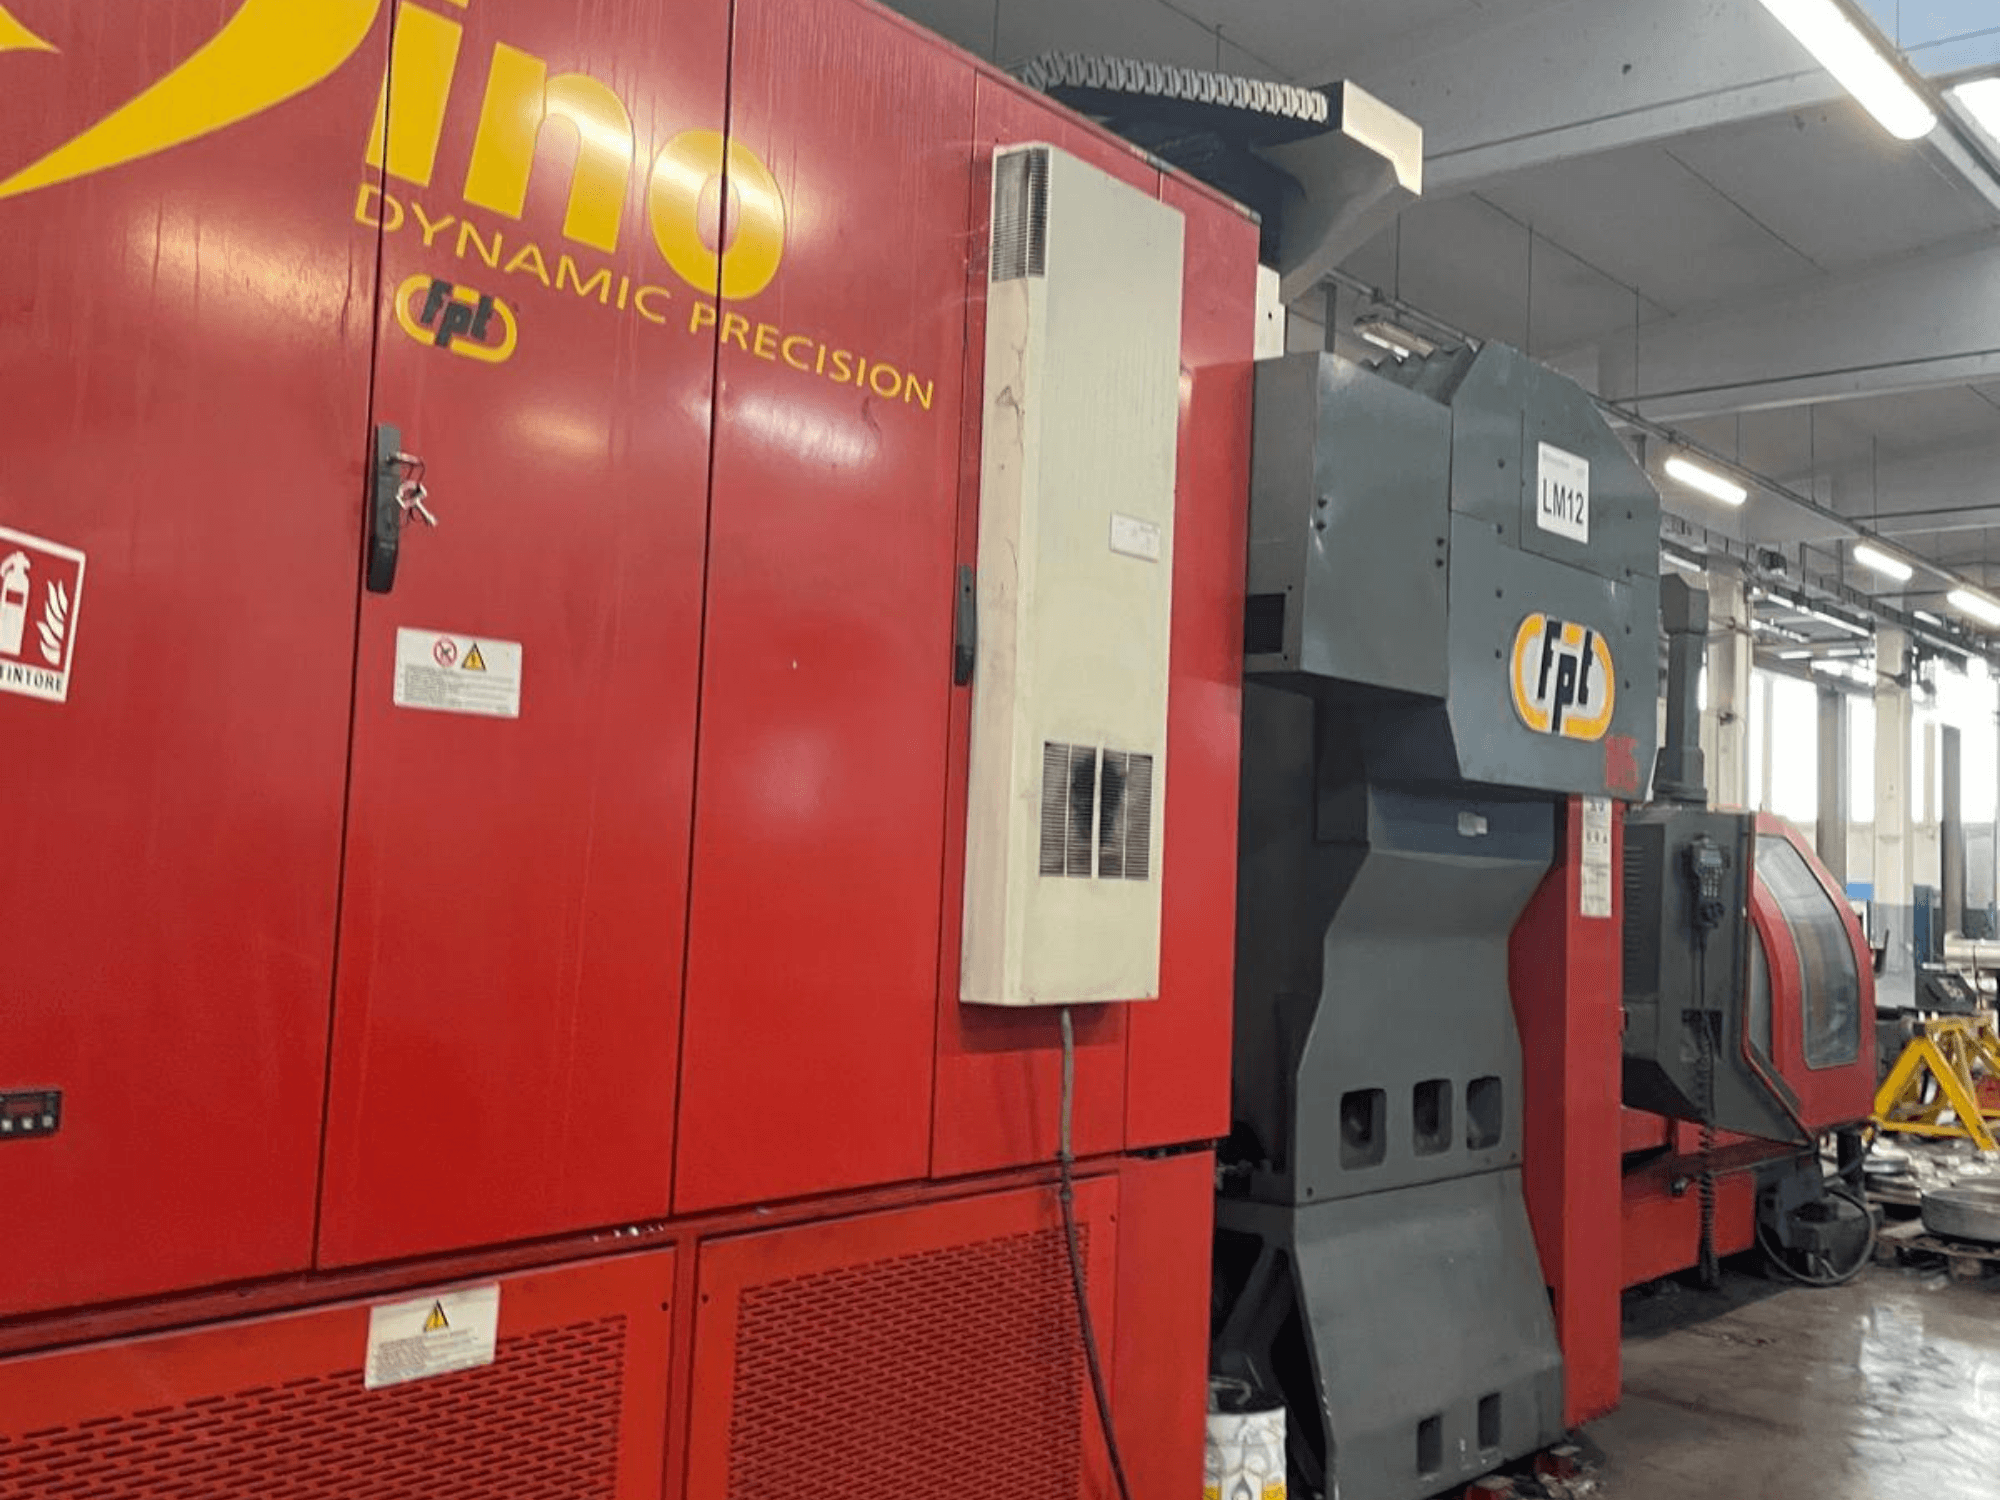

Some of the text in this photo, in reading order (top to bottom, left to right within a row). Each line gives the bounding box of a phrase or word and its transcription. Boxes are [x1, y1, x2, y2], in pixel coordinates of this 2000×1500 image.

[355, 182, 934, 410] DYNAMIC PRECISION
[1543, 478, 1584, 525] LM12
